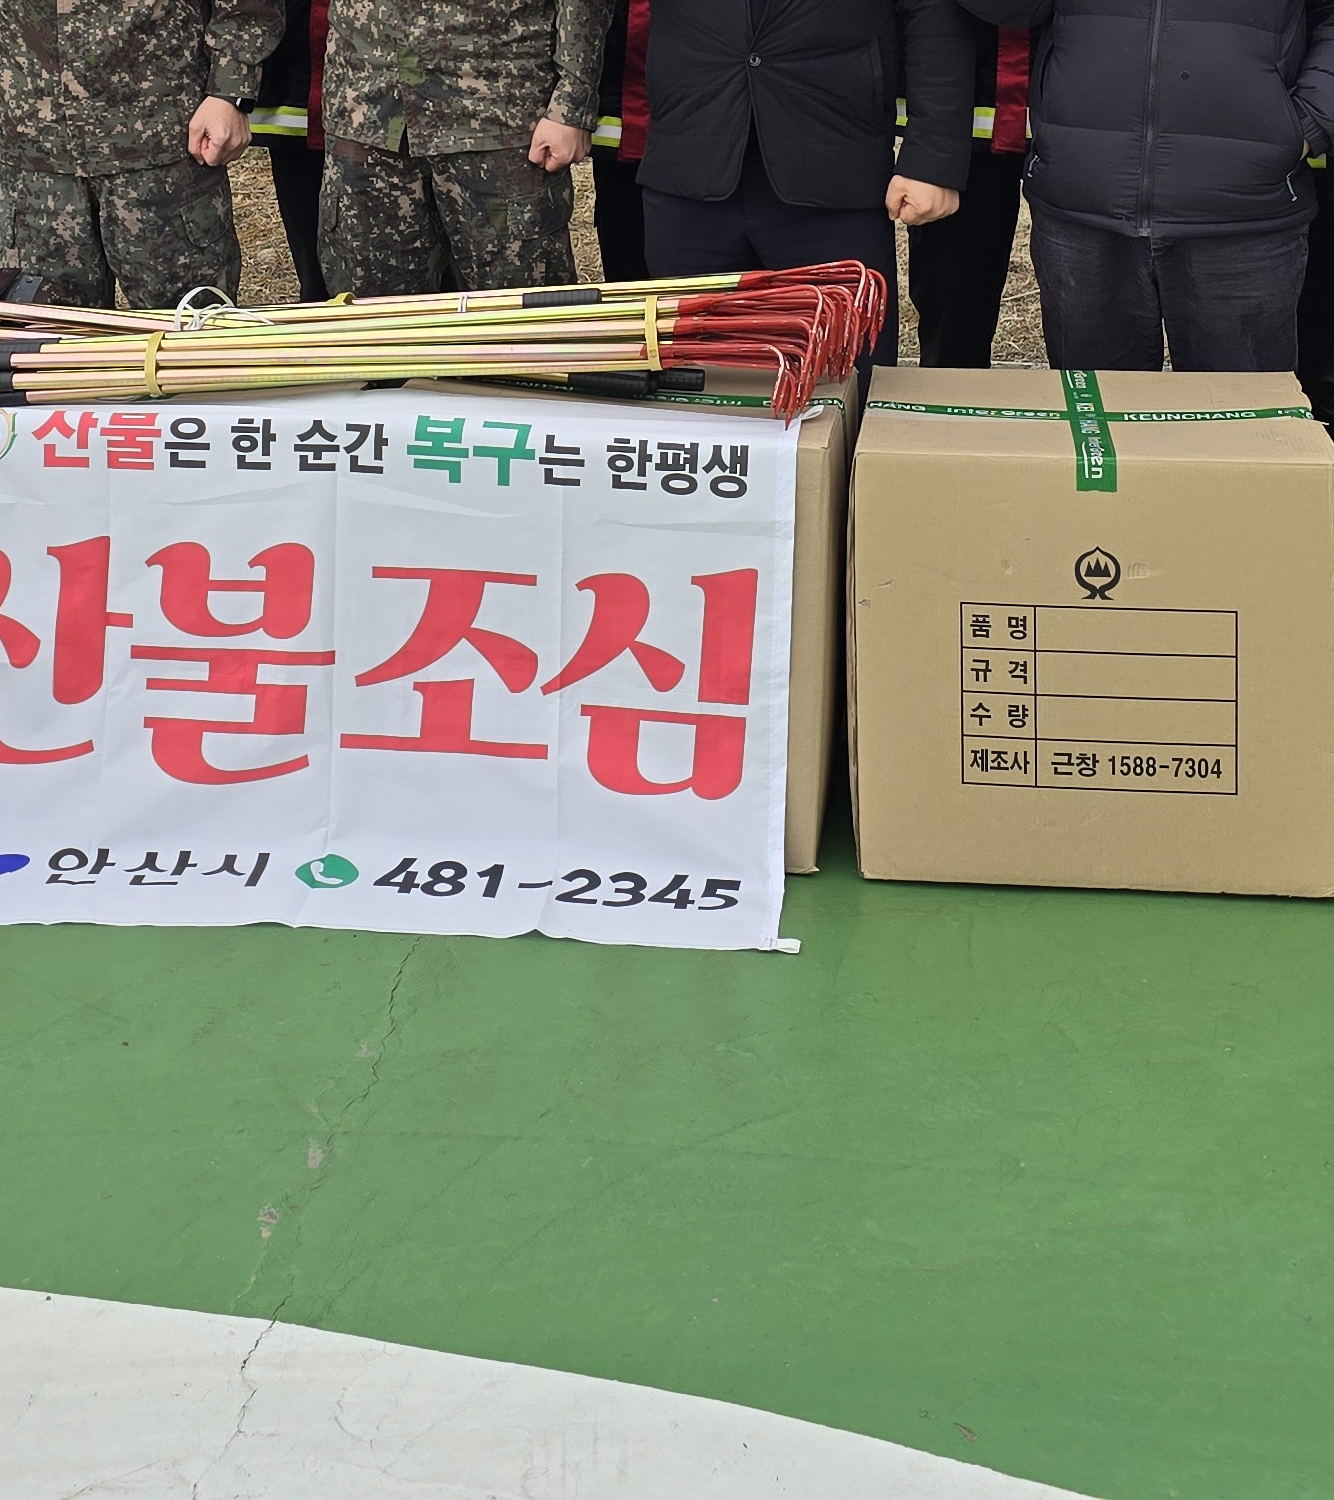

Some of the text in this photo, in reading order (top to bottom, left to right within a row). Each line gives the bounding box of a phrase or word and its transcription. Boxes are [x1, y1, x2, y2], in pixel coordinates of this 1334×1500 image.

[1124, 410, 1256, 421] KEUNCHANG
[231, 417, 276, 471] 한
[293, 419, 389, 475] 순간
[406, 415, 586, 487] 복구는
[606, 437, 749, 499] 한평생
[969, 748, 1223, 779] 제조사 근창 1588-7304
[45, 847, 742, 911] 안산시 481-2345
